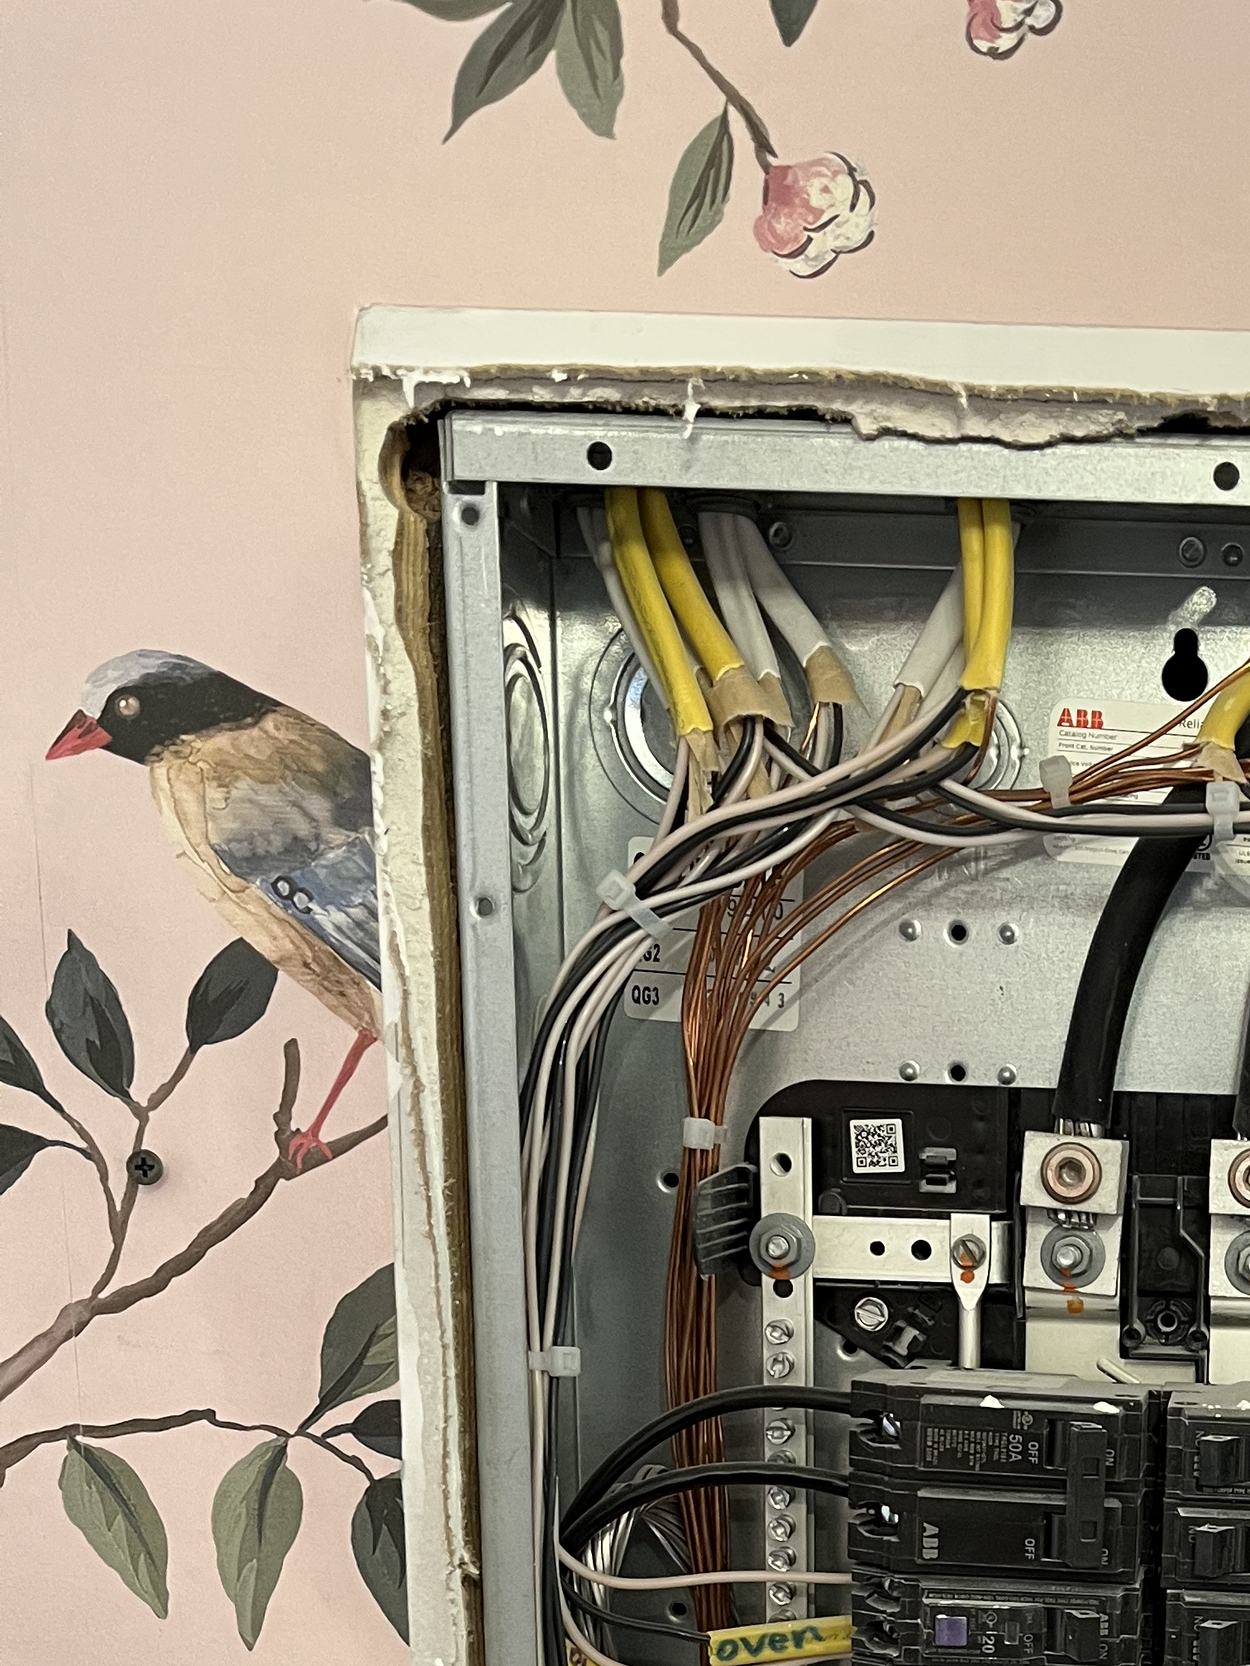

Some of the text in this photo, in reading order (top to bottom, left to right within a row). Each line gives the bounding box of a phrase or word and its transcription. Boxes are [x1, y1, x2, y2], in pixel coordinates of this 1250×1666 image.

[1057, 707, 1104, 730] ABB
[631, 985, 660, 1005] QG3
[1009, 1434, 1023, 1463] 50A
[1028, 1441, 1039, 1465] OFF
[1105, 1449, 1115, 1467] ON
[922, 1522, 940, 1560] ABB
[1024, 1538, 1035, 1560] OFF
[982, 1635, 995, 1654] 20
[1023, 1634, 1034, 1654] OFF
